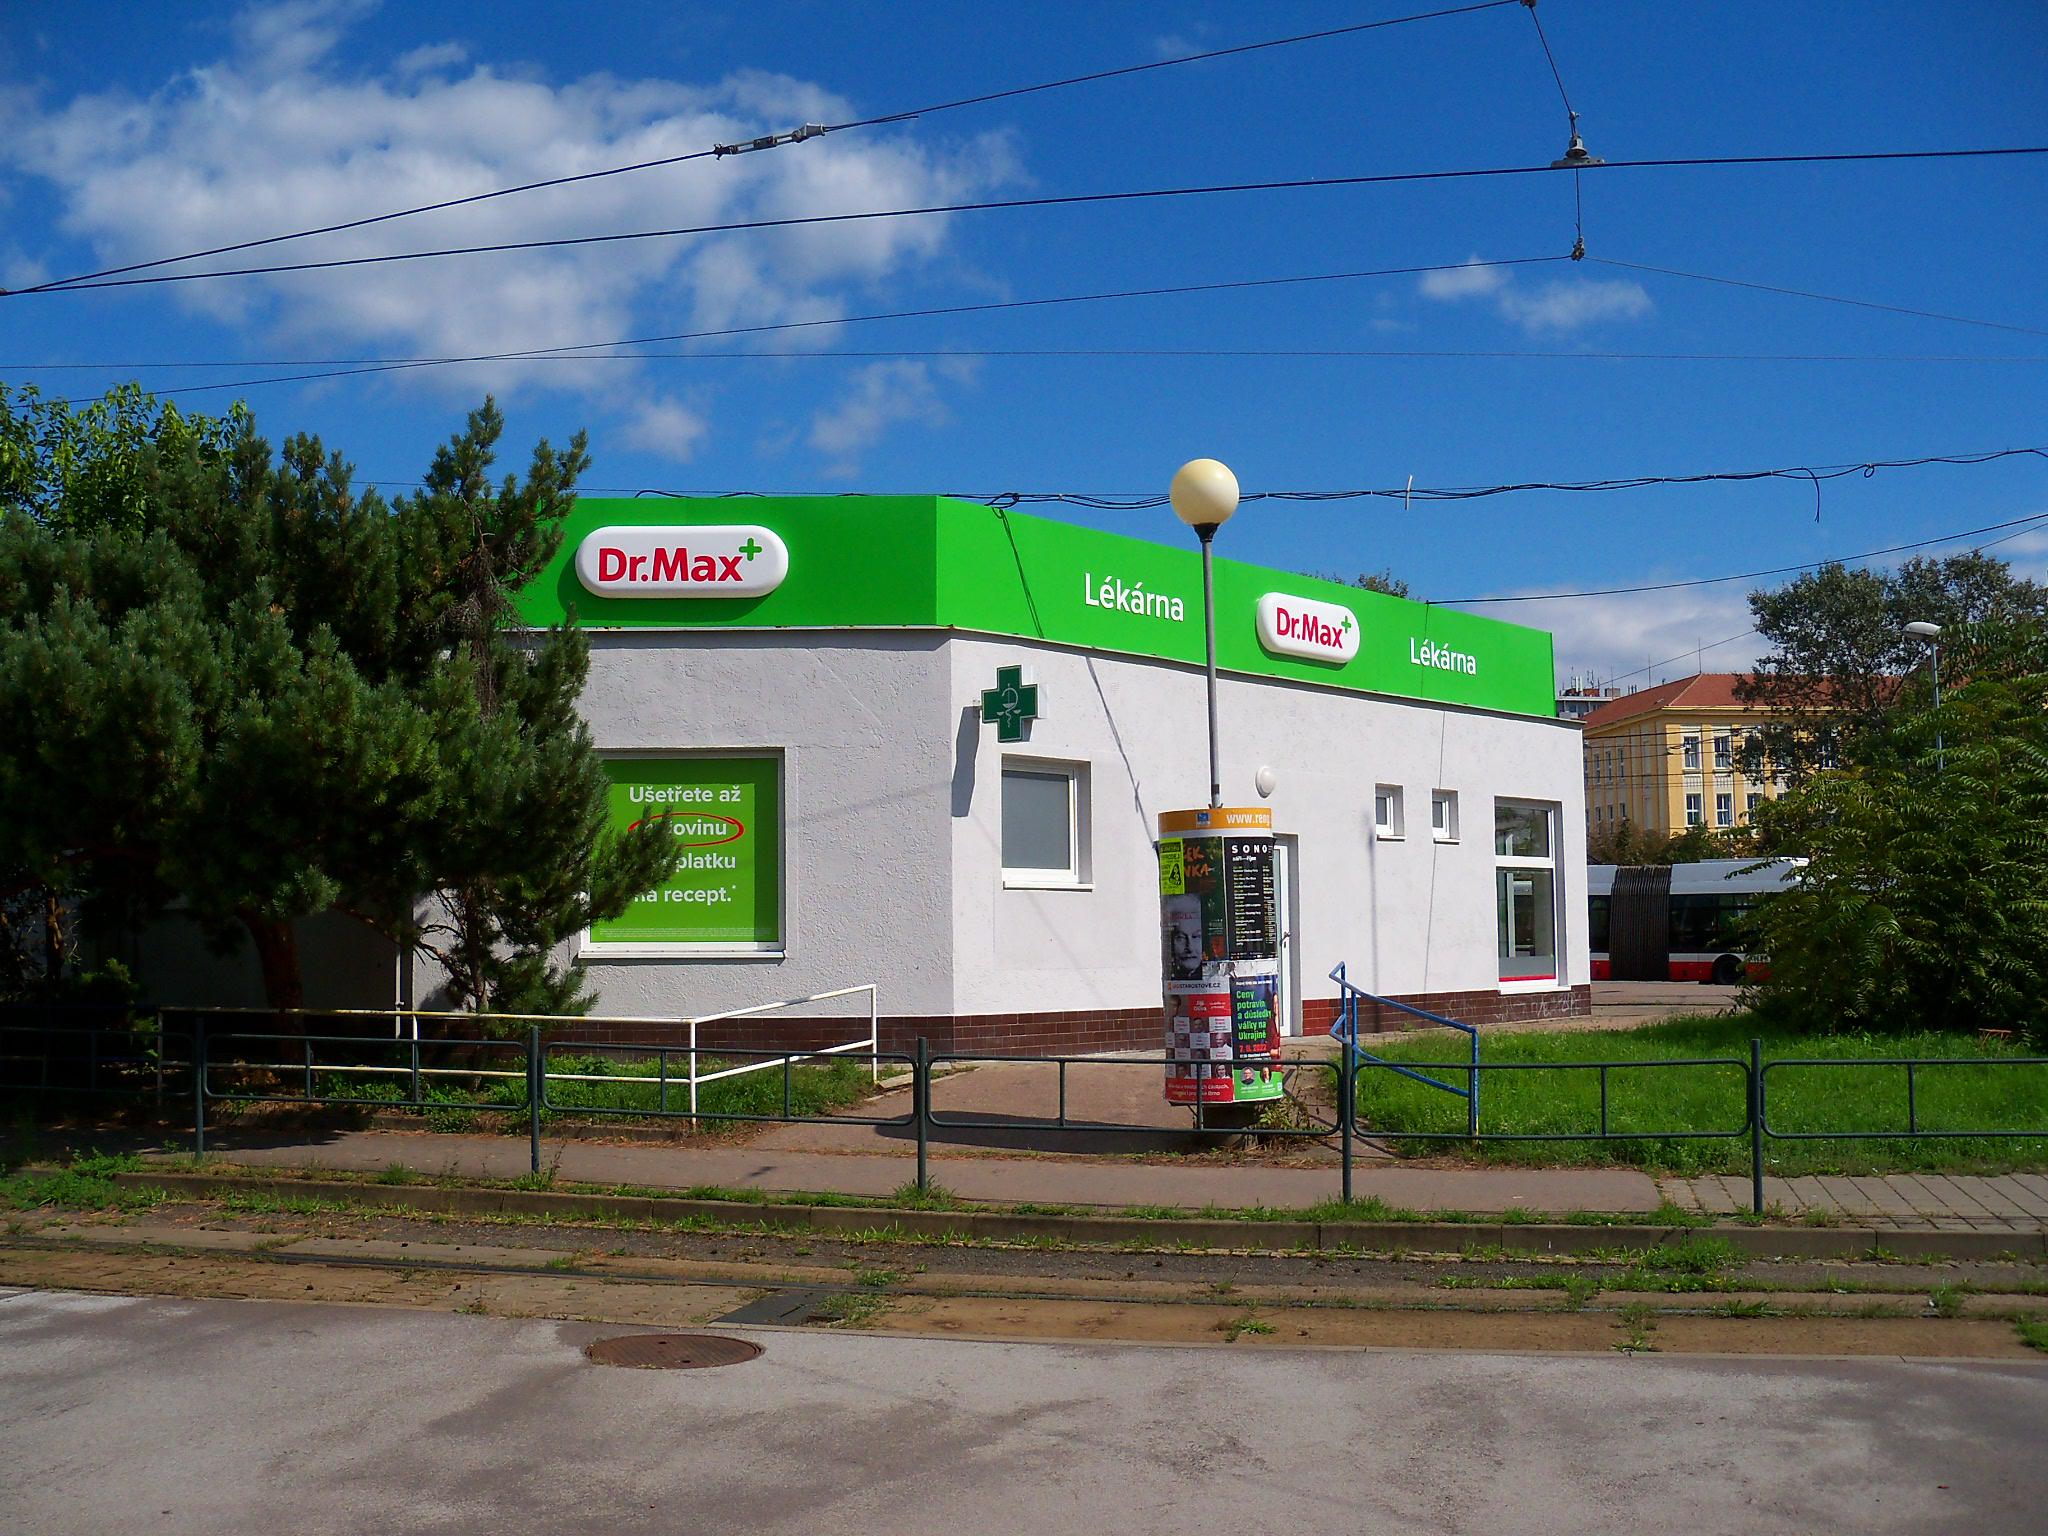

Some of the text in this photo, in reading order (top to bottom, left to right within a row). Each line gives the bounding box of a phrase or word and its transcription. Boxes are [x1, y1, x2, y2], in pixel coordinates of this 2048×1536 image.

[1085, 572, 1184, 622] Lékárna
[1410, 637, 1477, 675] Lékárna
[629, 785, 741, 803] Ušetřete až
[1231, 844, 1268, 854] SONO
[1236, 991, 1254, 999] Ceny
[1237, 1000, 1266, 1011] potravin
[1244, 1009, 1272, 1019] důsledky
[1237, 1021, 1257, 1030] války
[1238, 1030, 1267, 1041] Ukrajině
